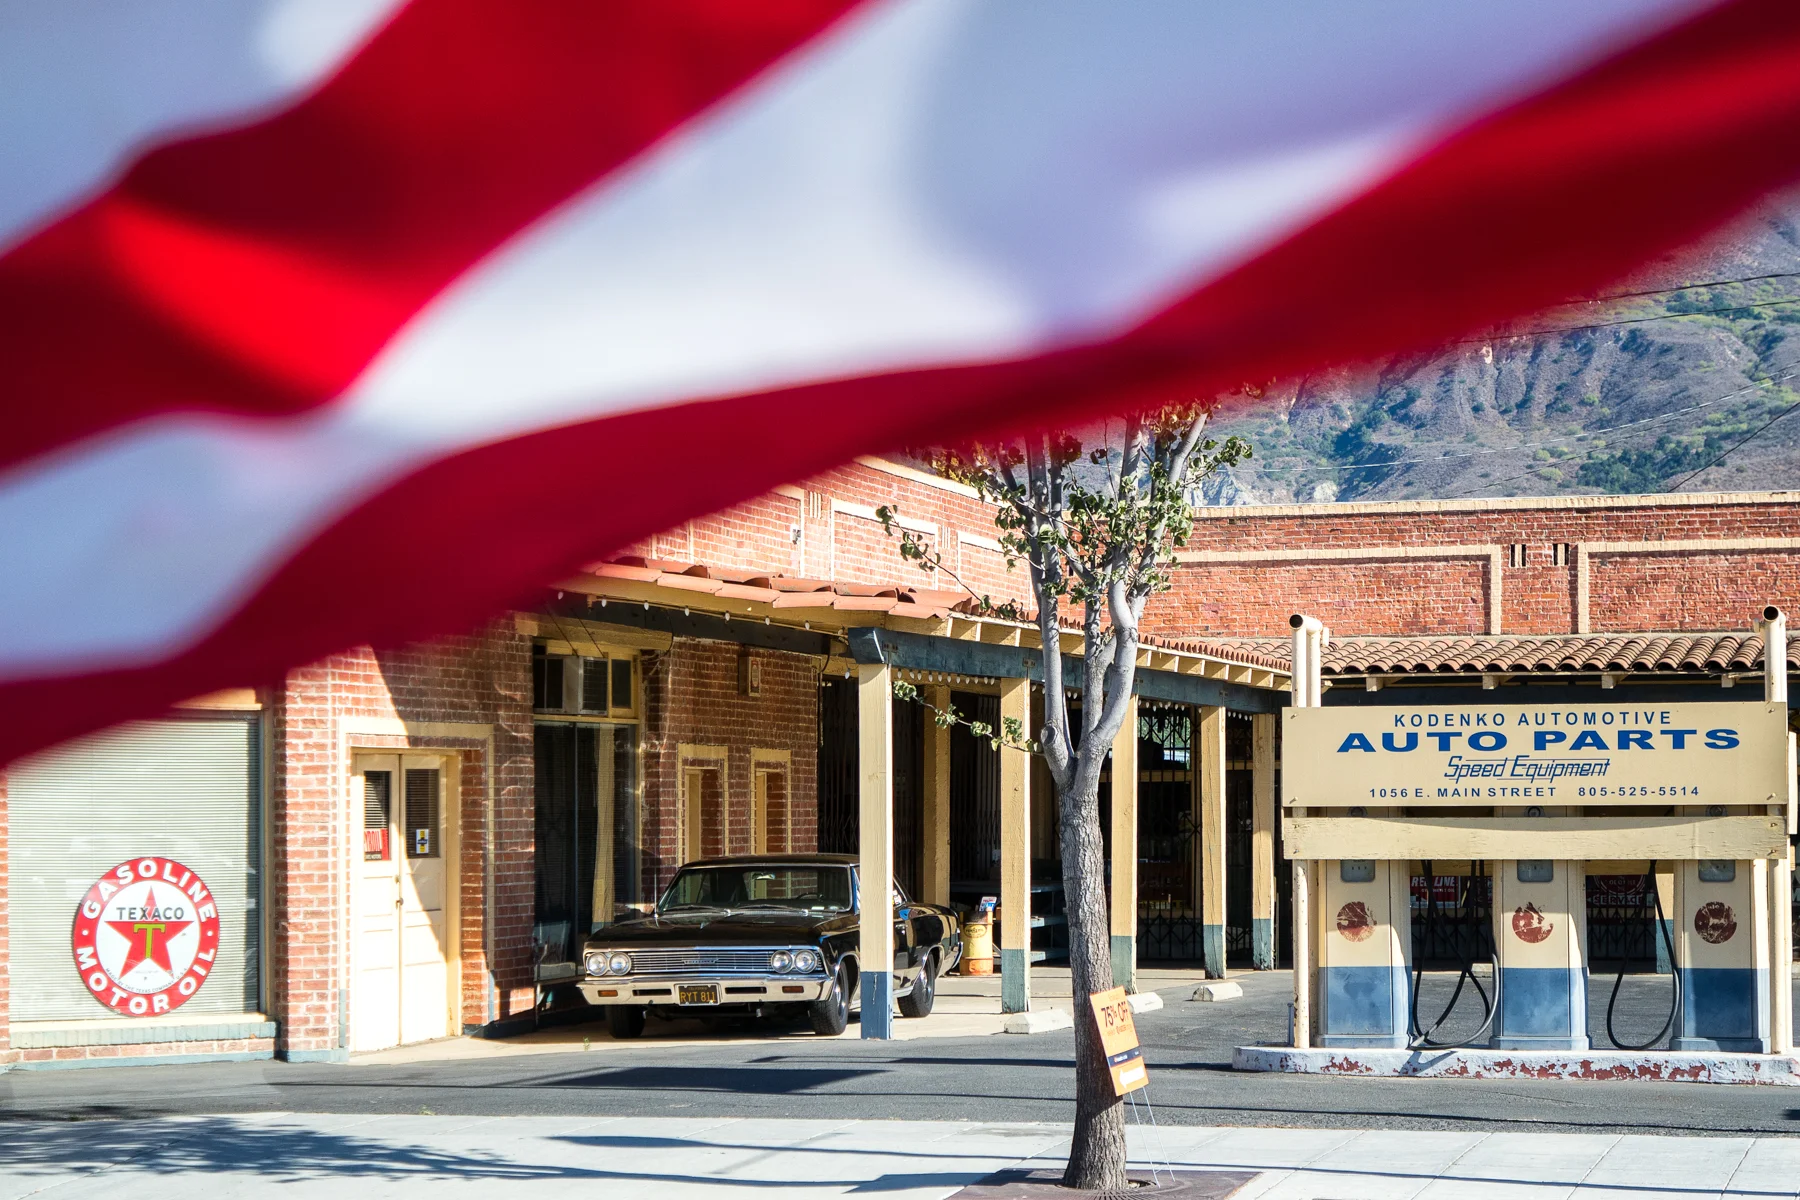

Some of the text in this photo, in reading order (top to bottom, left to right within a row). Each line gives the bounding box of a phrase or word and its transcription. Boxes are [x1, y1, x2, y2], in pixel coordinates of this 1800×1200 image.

[1394, 711, 1671, 727] KODENKO AUTOMOTIVE
[1336, 728, 1741, 753] AUTO PARTS
[1444, 755, 1611, 784] Speed Equipment
[1369, 786, 1700, 798] 1056 E. MAIN STREET 805-525-5514
[82, 859, 217, 923] GASOLINE
[1433, 876, 1456, 887] LINE
[116, 907, 185, 920] TEXACO
[133, 923, 166, 959] T
[76, 946, 215, 1015] MOTOR OIL
[680, 992, 716, 1002] RYT 811
